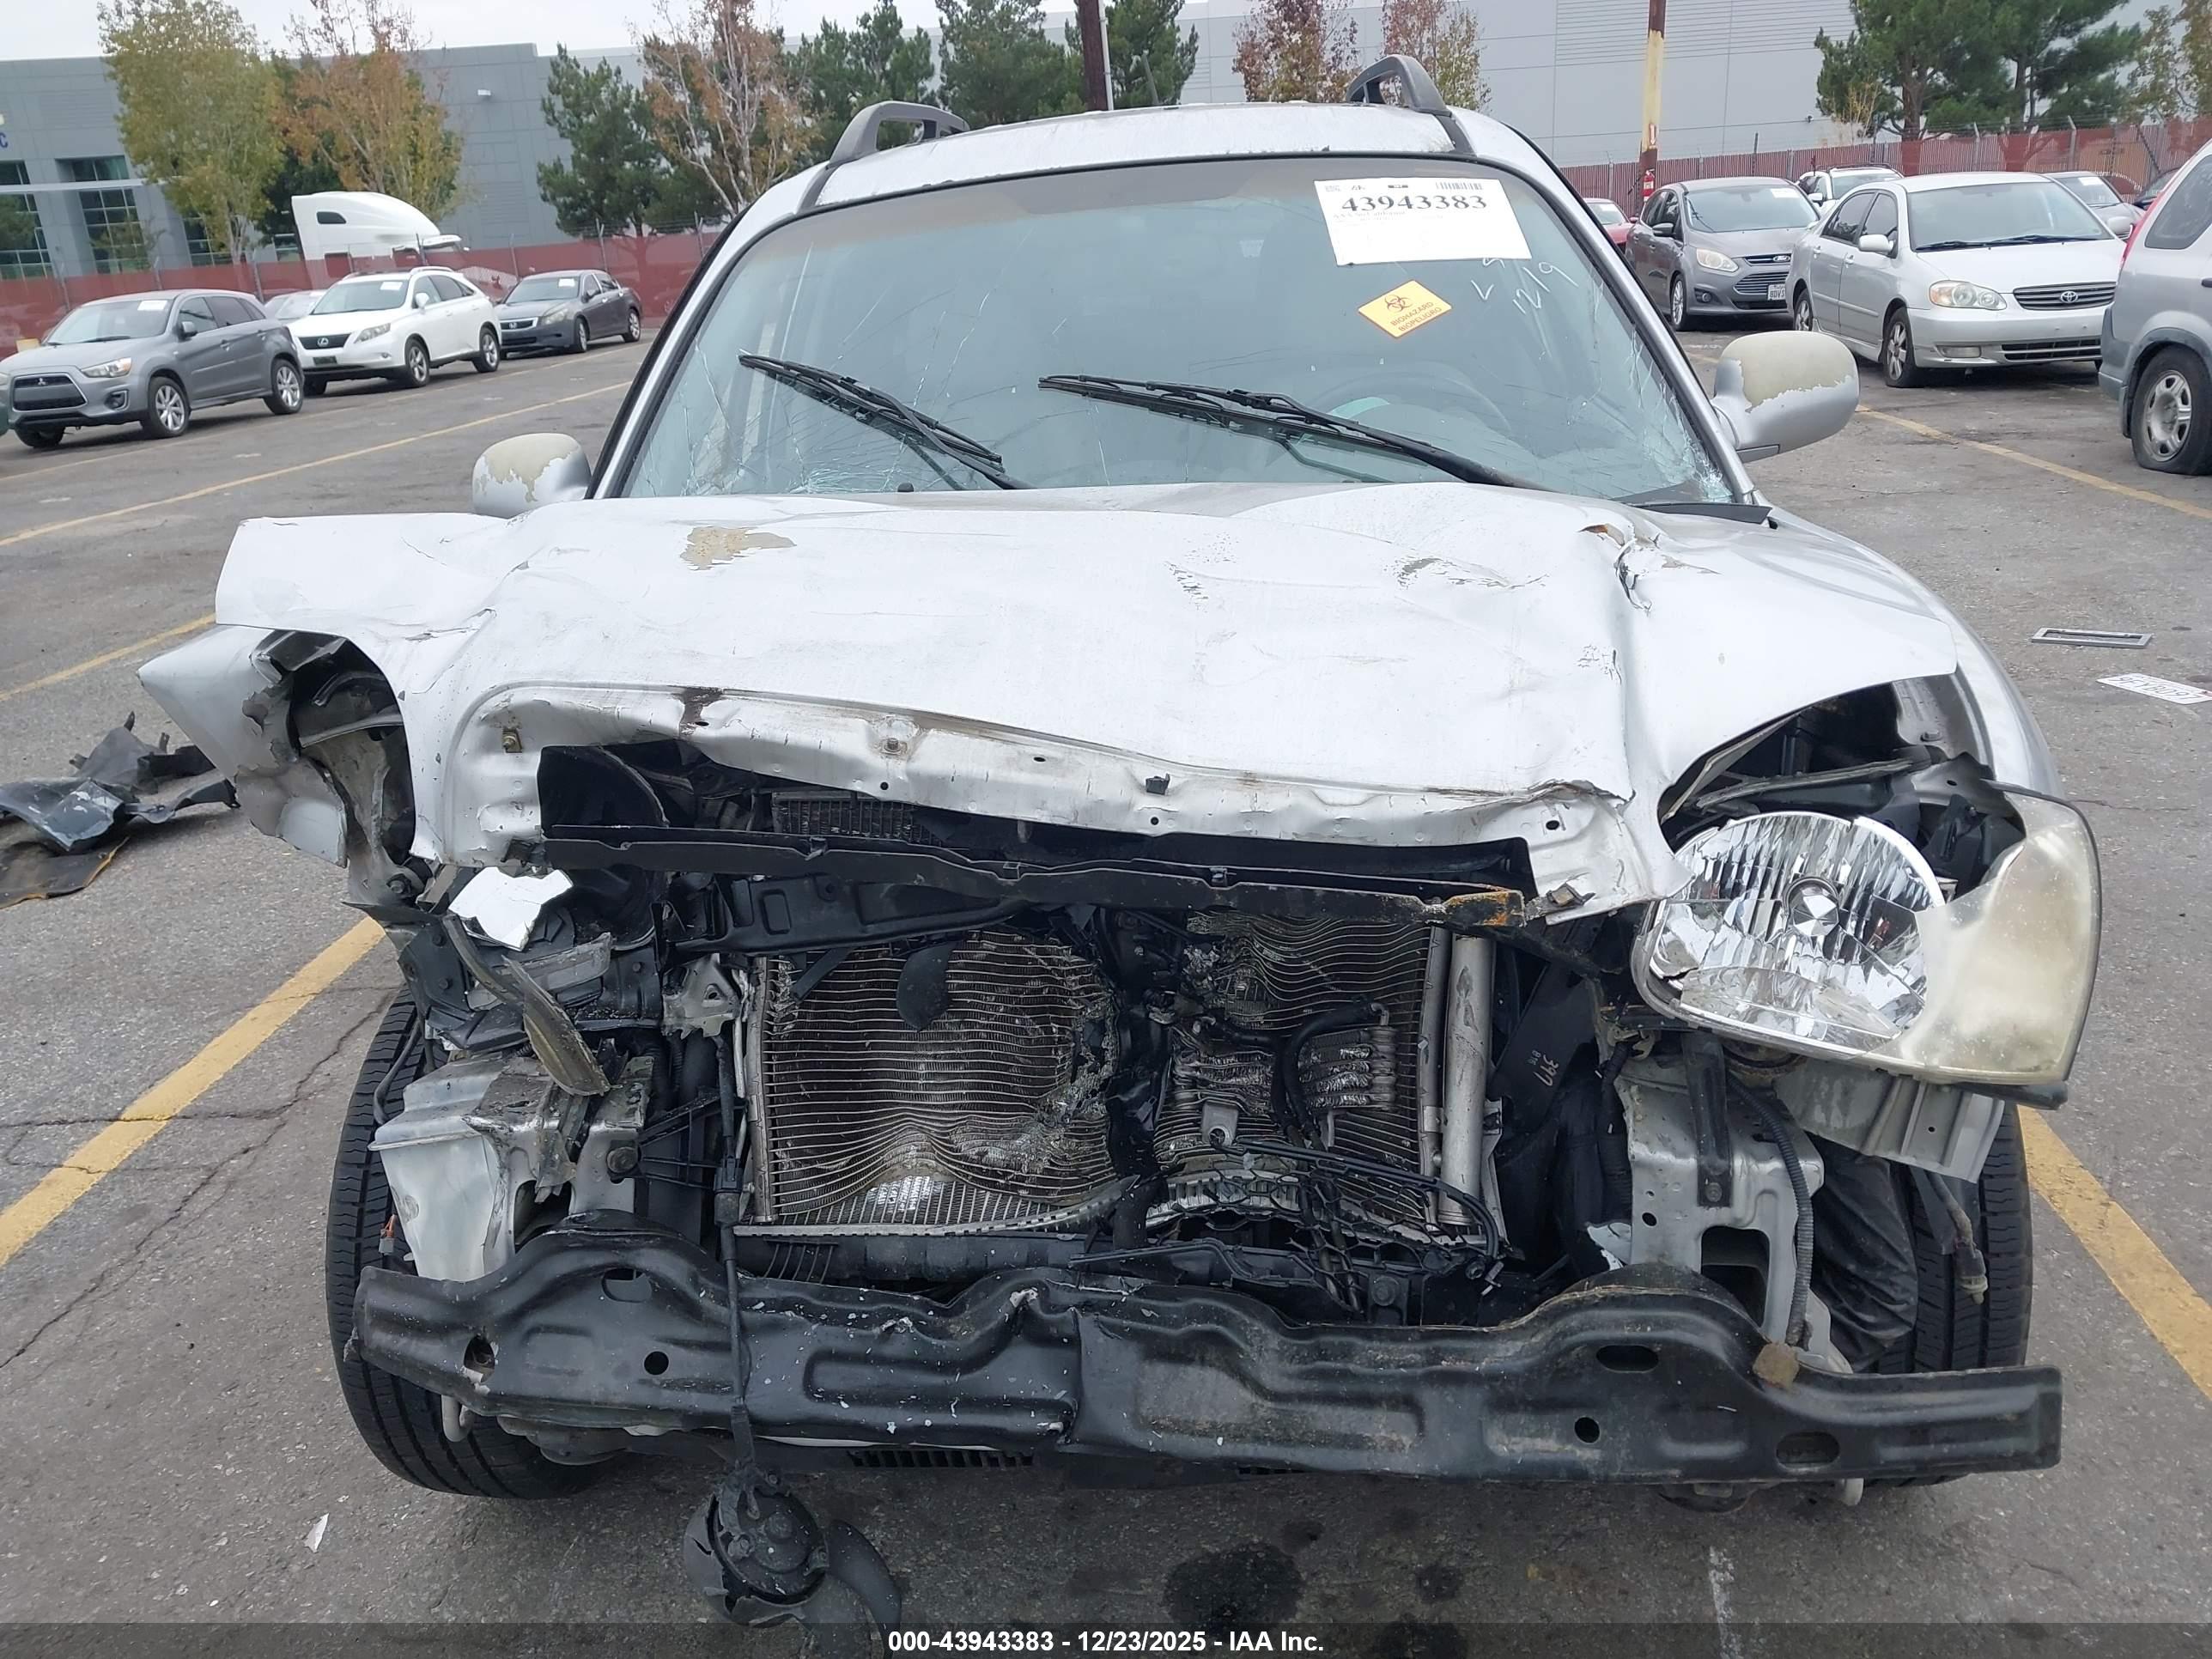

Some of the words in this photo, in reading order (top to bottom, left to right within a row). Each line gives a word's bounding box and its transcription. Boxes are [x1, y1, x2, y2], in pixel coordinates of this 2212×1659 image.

[1341, 195, 1487, 212] 43943383
[1390, 301, 1434, 326] BIOHAZARD
[1398, 307, 1443, 331] BIOPELIGRO
